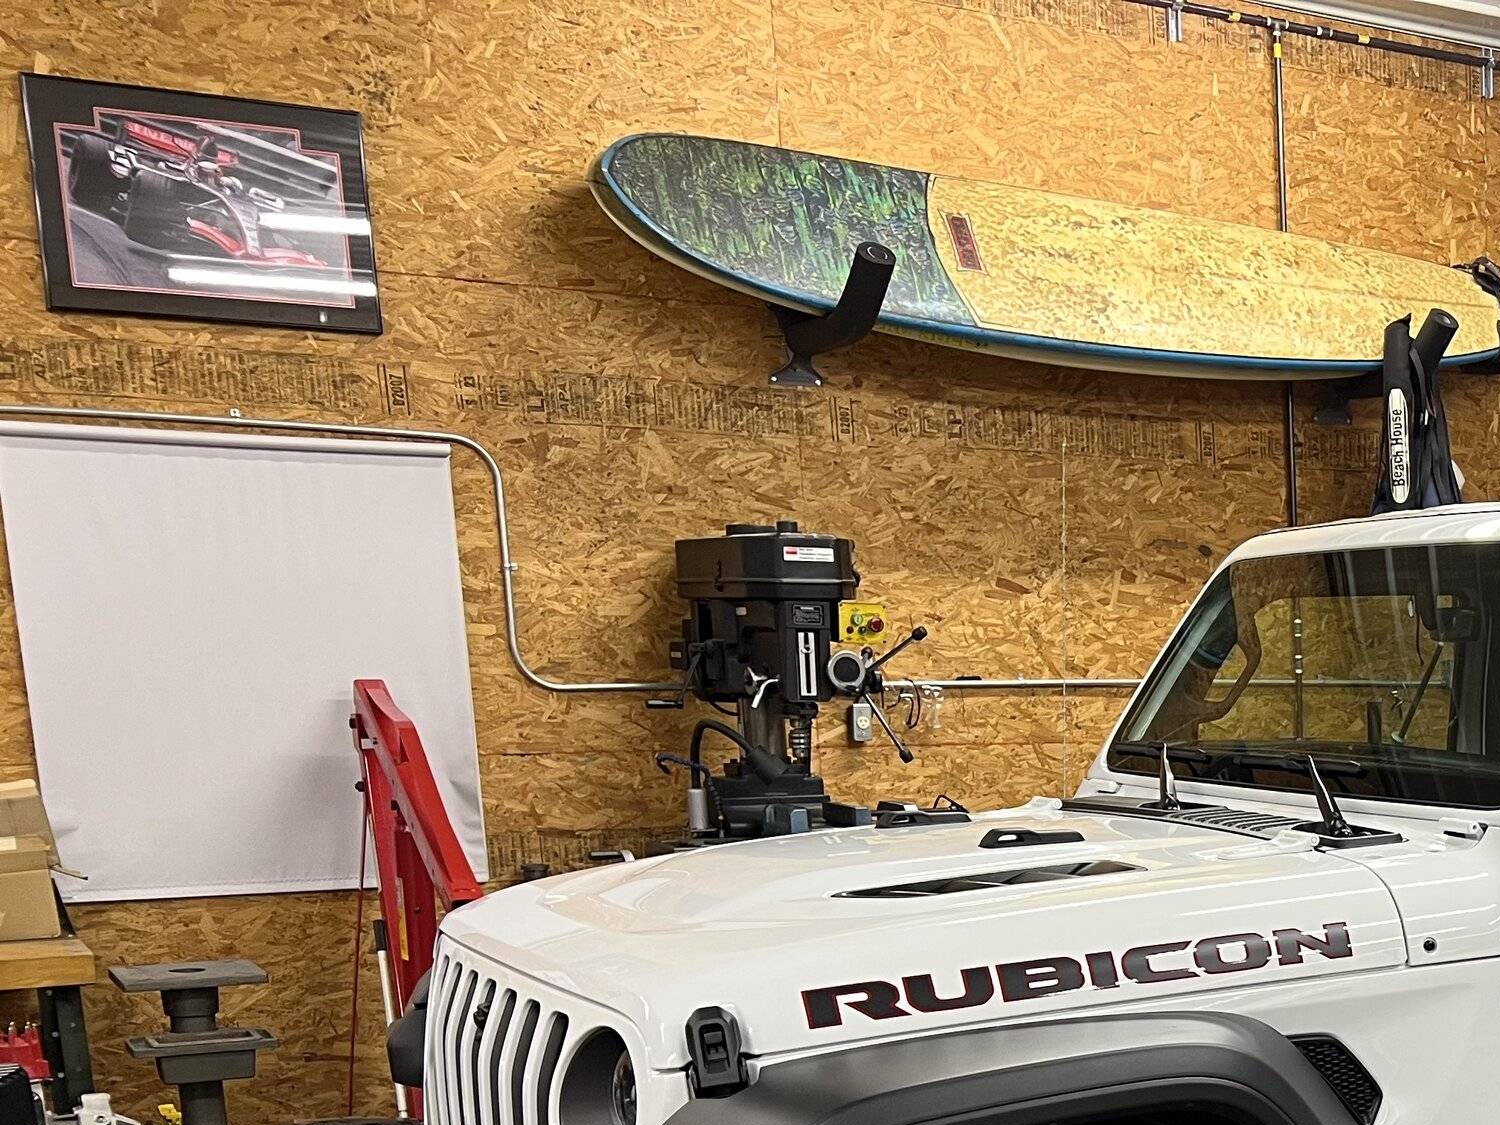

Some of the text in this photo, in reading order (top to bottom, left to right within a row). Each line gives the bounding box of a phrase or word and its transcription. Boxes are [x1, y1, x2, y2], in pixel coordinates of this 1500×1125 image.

[1391, 409, 1405, 487] Beach House
[801, 922, 1353, 1029] RUBICON
